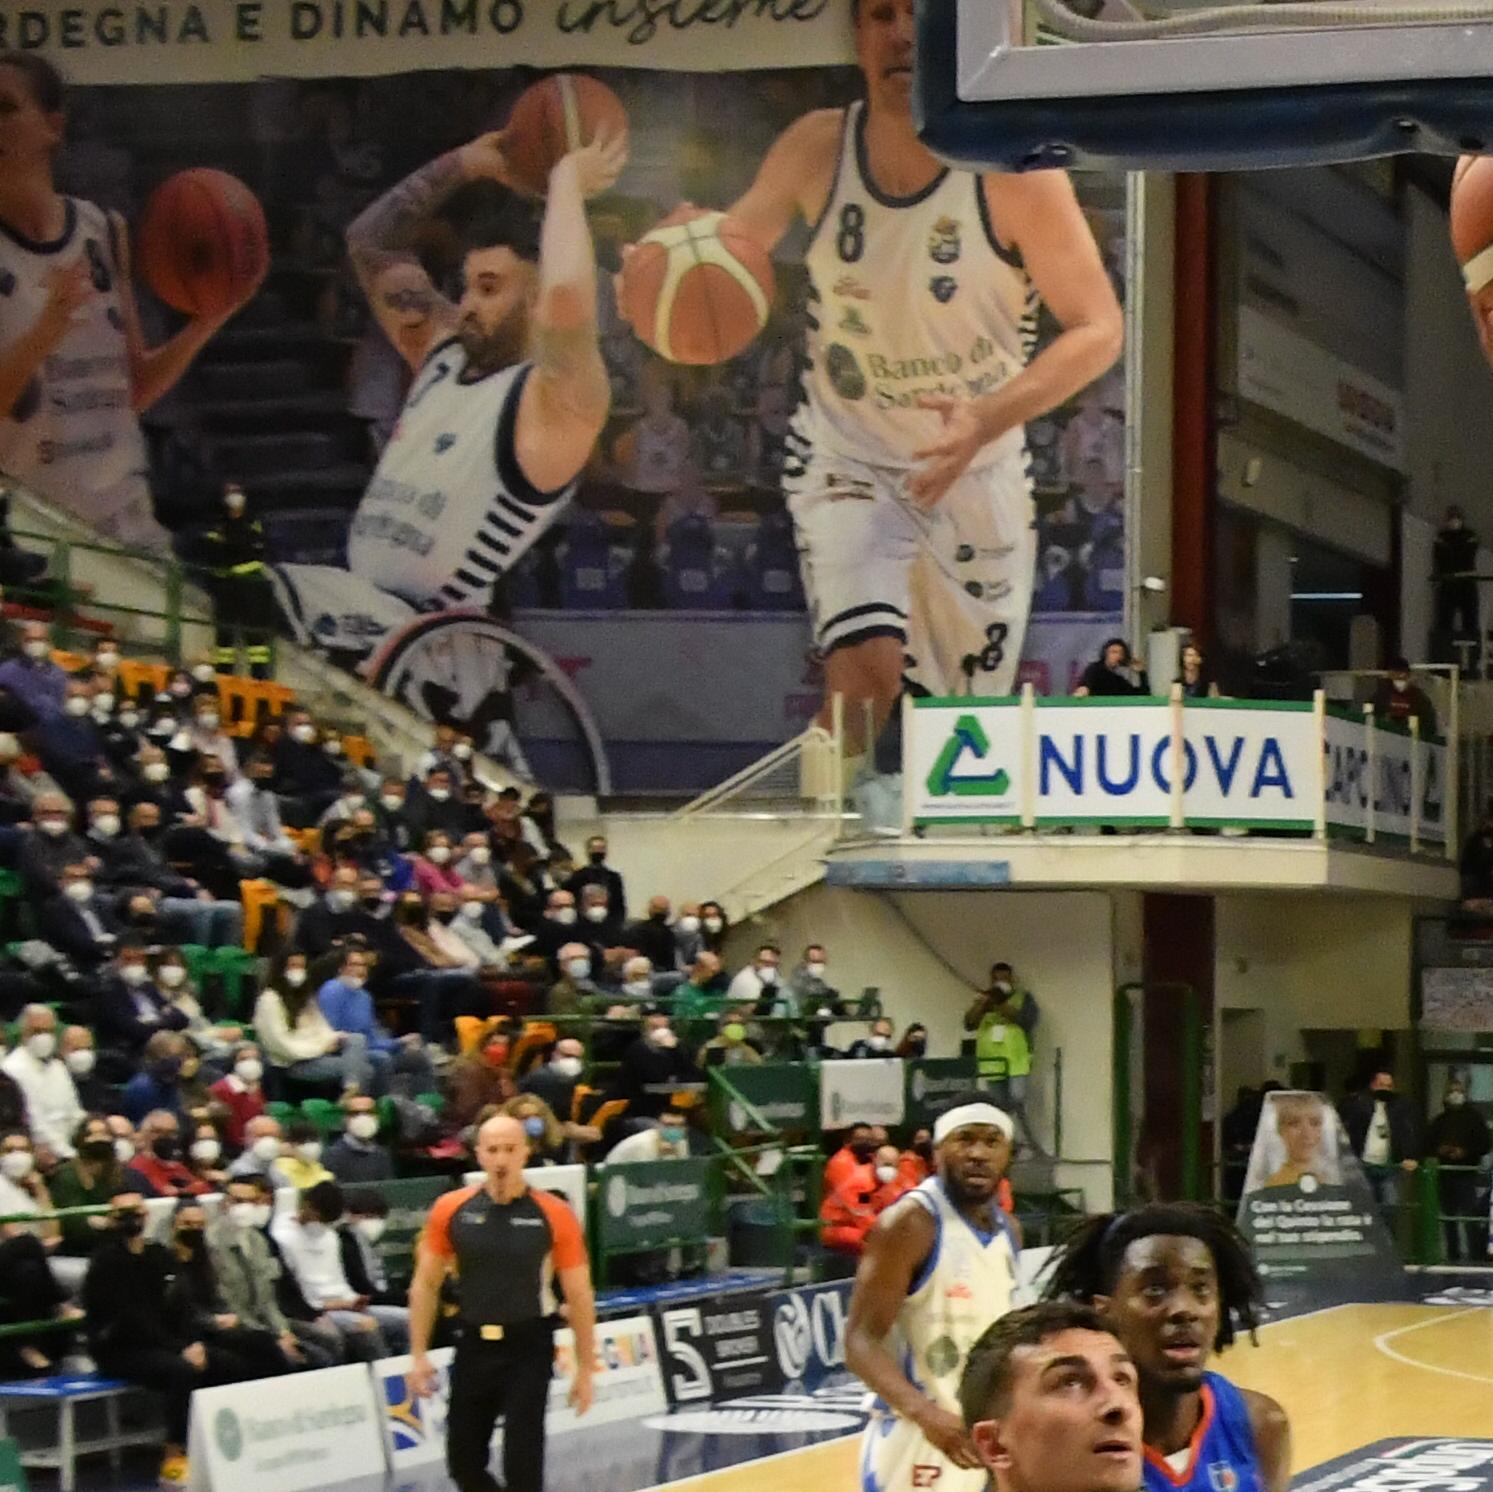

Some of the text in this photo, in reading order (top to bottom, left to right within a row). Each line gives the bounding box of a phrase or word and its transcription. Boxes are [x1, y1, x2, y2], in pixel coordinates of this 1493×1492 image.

[0, 7, 208, 49] DEGNA
[237, 4, 263, 41] E
[291, 0, 523, 39] DINAMO
[837, 204, 864, 263] 8
[1040, 733, 1295, 799] NUOVA
